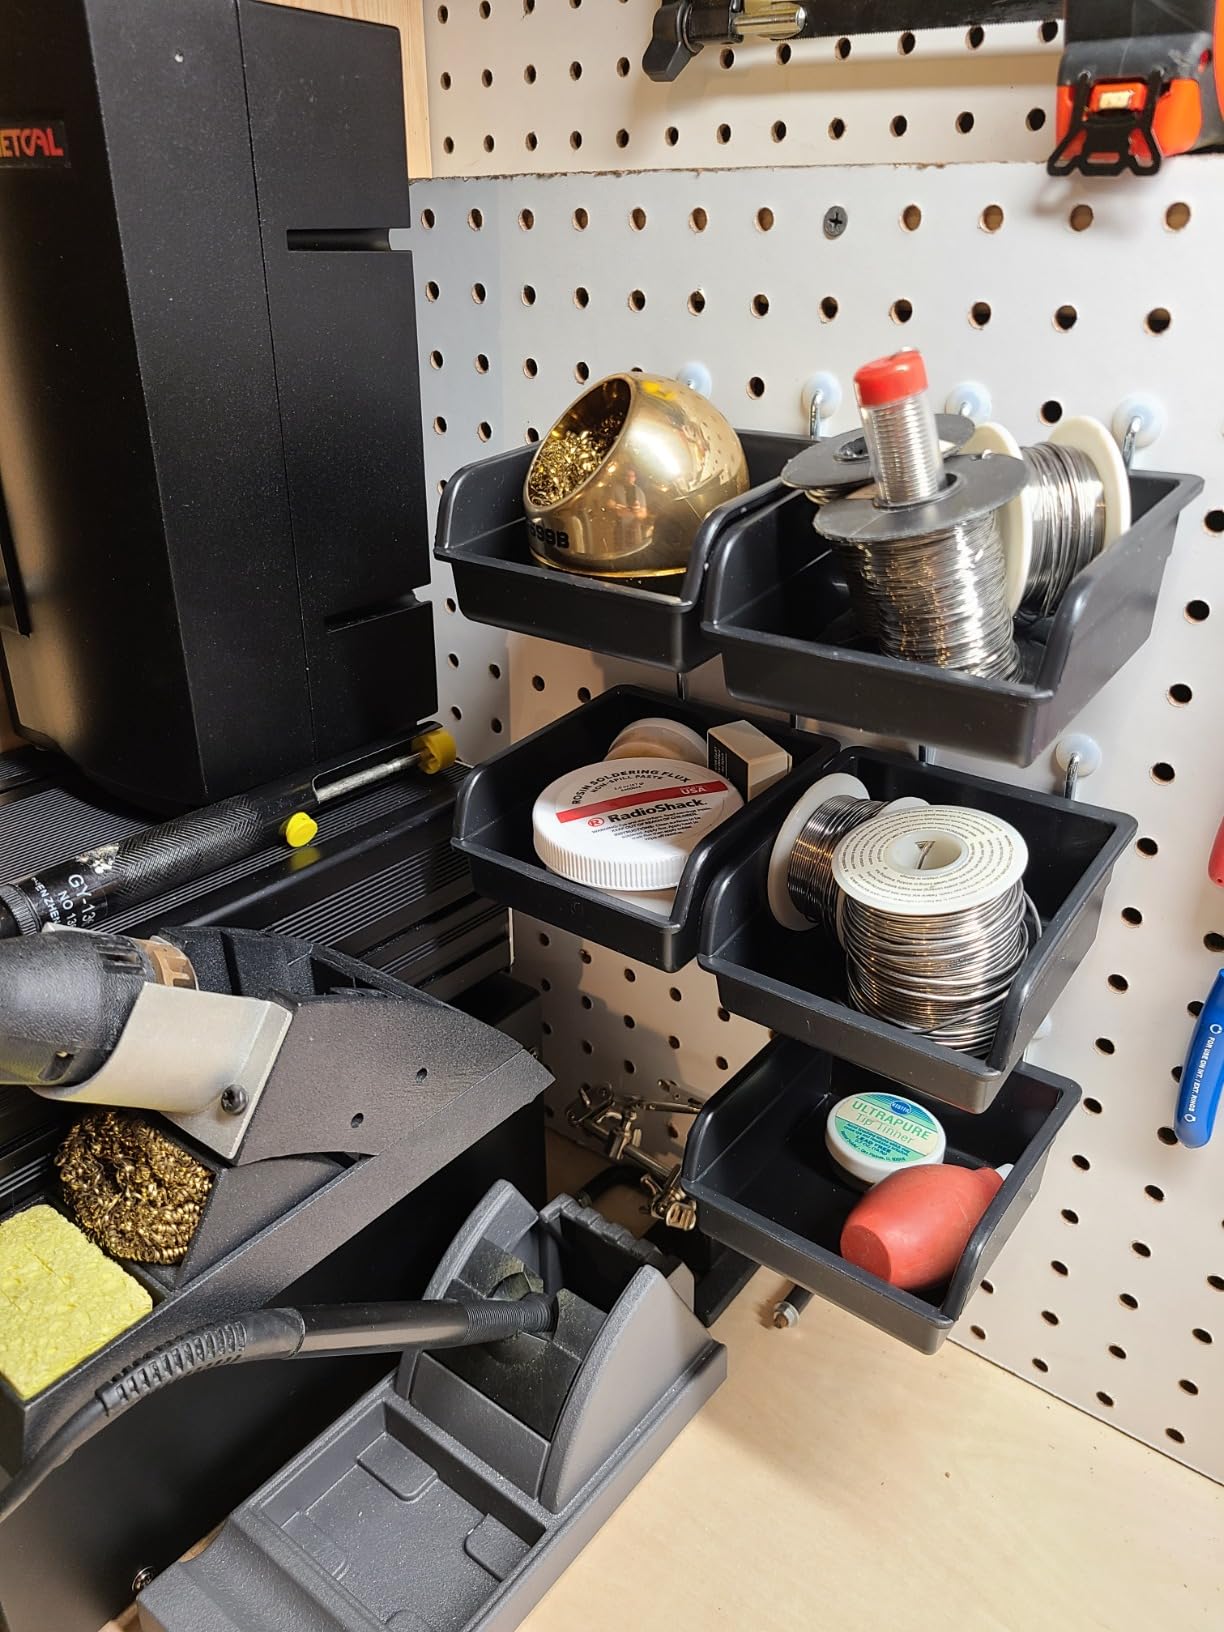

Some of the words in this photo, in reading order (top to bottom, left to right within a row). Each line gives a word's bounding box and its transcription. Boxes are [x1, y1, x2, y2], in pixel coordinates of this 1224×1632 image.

[0, 128, 64, 158] ETCAL
[571, 784, 592, 805] ROSIN
[589, 770, 660, 786] SOLDERING
[661, 771, 691, 783] FLUX
[590, 775, 633, 793] NON-SPILL
[680, 786, 707, 795] USA
[58, 890, 74, 910] NO
[1206, 1037, 1216, 1049] FOR
[1202, 1048, 1211, 1060] USE
[1192, 1081, 1201, 1094] EXT.
[1188, 1094, 1198, 1112] RINGS
[852, 1100, 931, 1140] ULTRAPURE
[856, 1113, 873, 1126] Tip
[877, 1121, 916, 1144] Tinner
